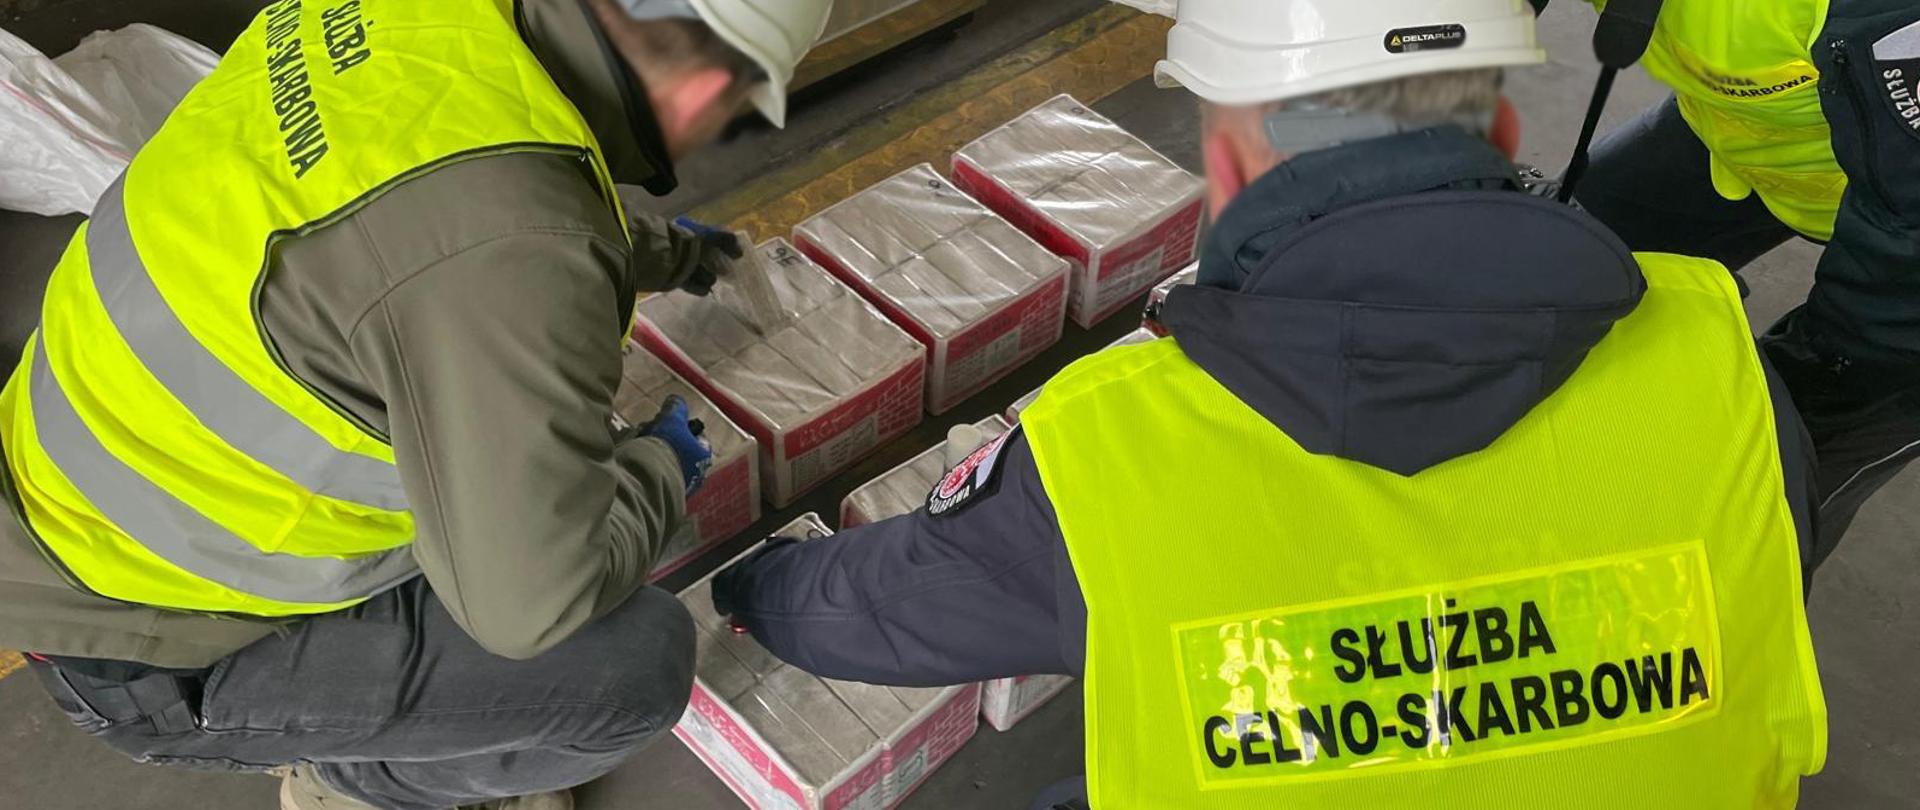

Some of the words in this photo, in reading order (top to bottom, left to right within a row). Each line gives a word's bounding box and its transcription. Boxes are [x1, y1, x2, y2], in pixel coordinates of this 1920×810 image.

[321, 0, 374, 76] SŁUŻBA
[1330, 598, 1557, 684] SŁUŻBA
[1203, 646, 1710, 769] CELNO-SKARBOWA
